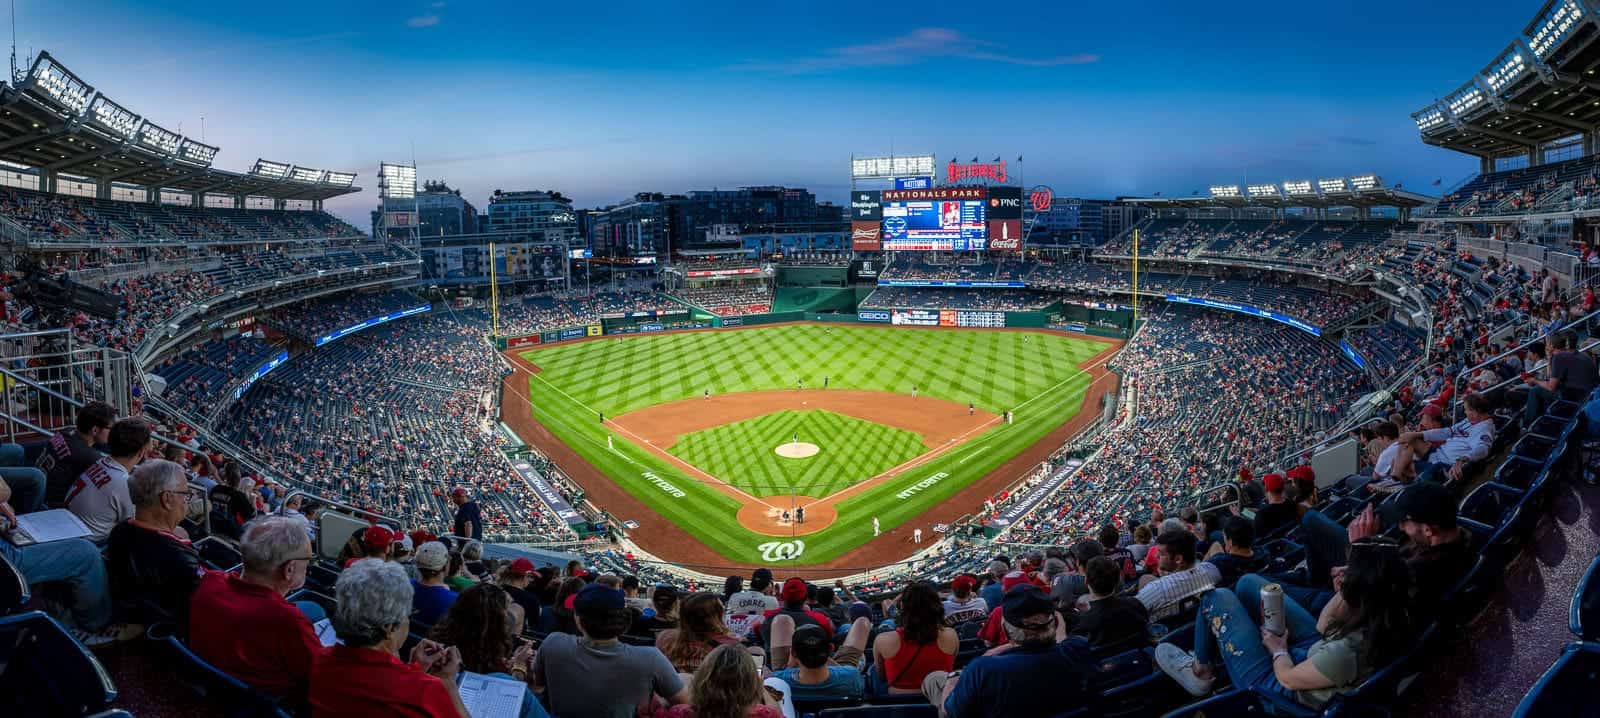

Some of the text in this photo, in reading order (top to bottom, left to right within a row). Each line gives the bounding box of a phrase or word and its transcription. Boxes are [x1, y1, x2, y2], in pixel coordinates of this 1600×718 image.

[947, 160, 1007, 183] NATIONALS
[886, 190, 947, 198] NATIONALS
[1000, 198, 1020, 207] PNC
[860, 311, 888, 320] GEICO
